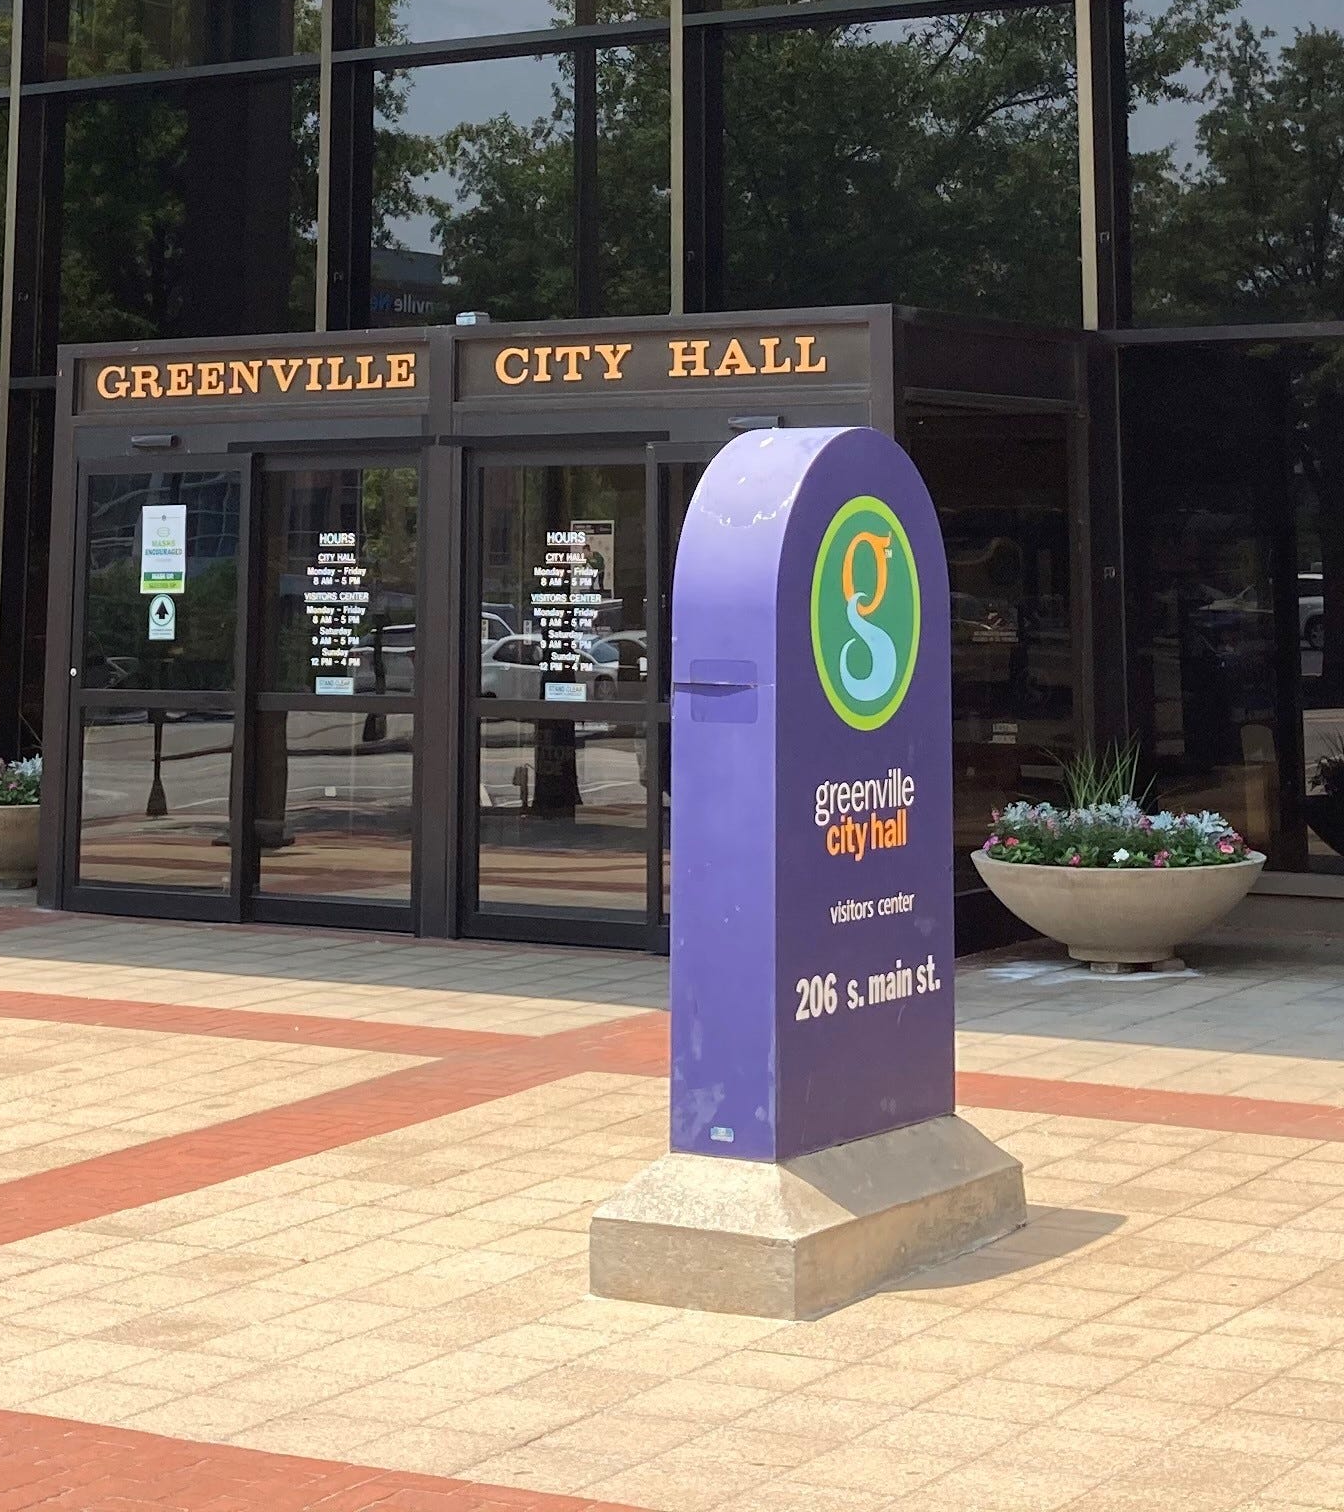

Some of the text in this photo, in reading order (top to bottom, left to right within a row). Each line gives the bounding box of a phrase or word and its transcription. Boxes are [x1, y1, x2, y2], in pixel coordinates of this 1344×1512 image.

[97, 336, 827, 399] GREENVILLE CITY HALL
[319, 533, 355, 544] HOURS
[547, 532, 585, 543] HOURS
[318, 553, 356, 561] CITY HALL
[546, 553, 586, 561] CITY HALL
[307, 567, 335, 576] Monday
[344, 567, 366, 576] Friday
[534, 567, 564, 577] Monday
[574, 567, 598, 577] Friday
[313, 577, 319, 585] 8
[321, 577, 333, 585] AM
[341, 577, 347, 585] 5
[349, 577, 360, 585] PM
[541, 577, 547, 586] 8
[549, 578, 562, 586] AM
[572, 578, 577, 586] 5
[580, 578, 592, 586] PM
[304, 592, 369, 600] VISITORS CENTER
[531, 594, 601, 602] VISITORS CENTER
[307, 606, 334, 615] Monday
[343, 606, 366, 615] Friday
[534, 608, 564, 618] Monday
[574, 608, 598, 619] Friday
[313, 616, 318, 624] 8
[341, 616, 346, 624] 5
[348, 616, 360, 624] PM
[540, 618, 546, 626] 8
[548, 618, 561, 626] AM
[571, 618, 577, 627] 5
[579, 618, 592, 627] PM
[320, 627, 352, 636] Saturday
[548, 630, 583, 640] Saturday
[312, 636, 318, 645] 9
[340, 637, 346, 645] 5
[540, 640, 546, 648] 9
[549, 640, 561, 648] AM
[571, 640, 577, 648] 5
[580, 640, 591, 649] PM
[322, 648, 349, 657] Sunday
[551, 652, 580, 662] Sunday
[311, 658, 319, 666] 12
[321, 658, 332, 666] PM
[341, 658, 346, 666] 4
[348, 658, 360, 666] PM
[539, 662, 548, 671] 12
[550, 662, 562, 671] PM
[572, 662, 578, 671] 4
[580, 663, 593, 671] PM
[815, 768, 915, 826] greenville
[826, 809, 907, 861] city hall
[830, 891, 915, 924] visitors center
[795, 954, 941, 1021] 206 s. main st.
